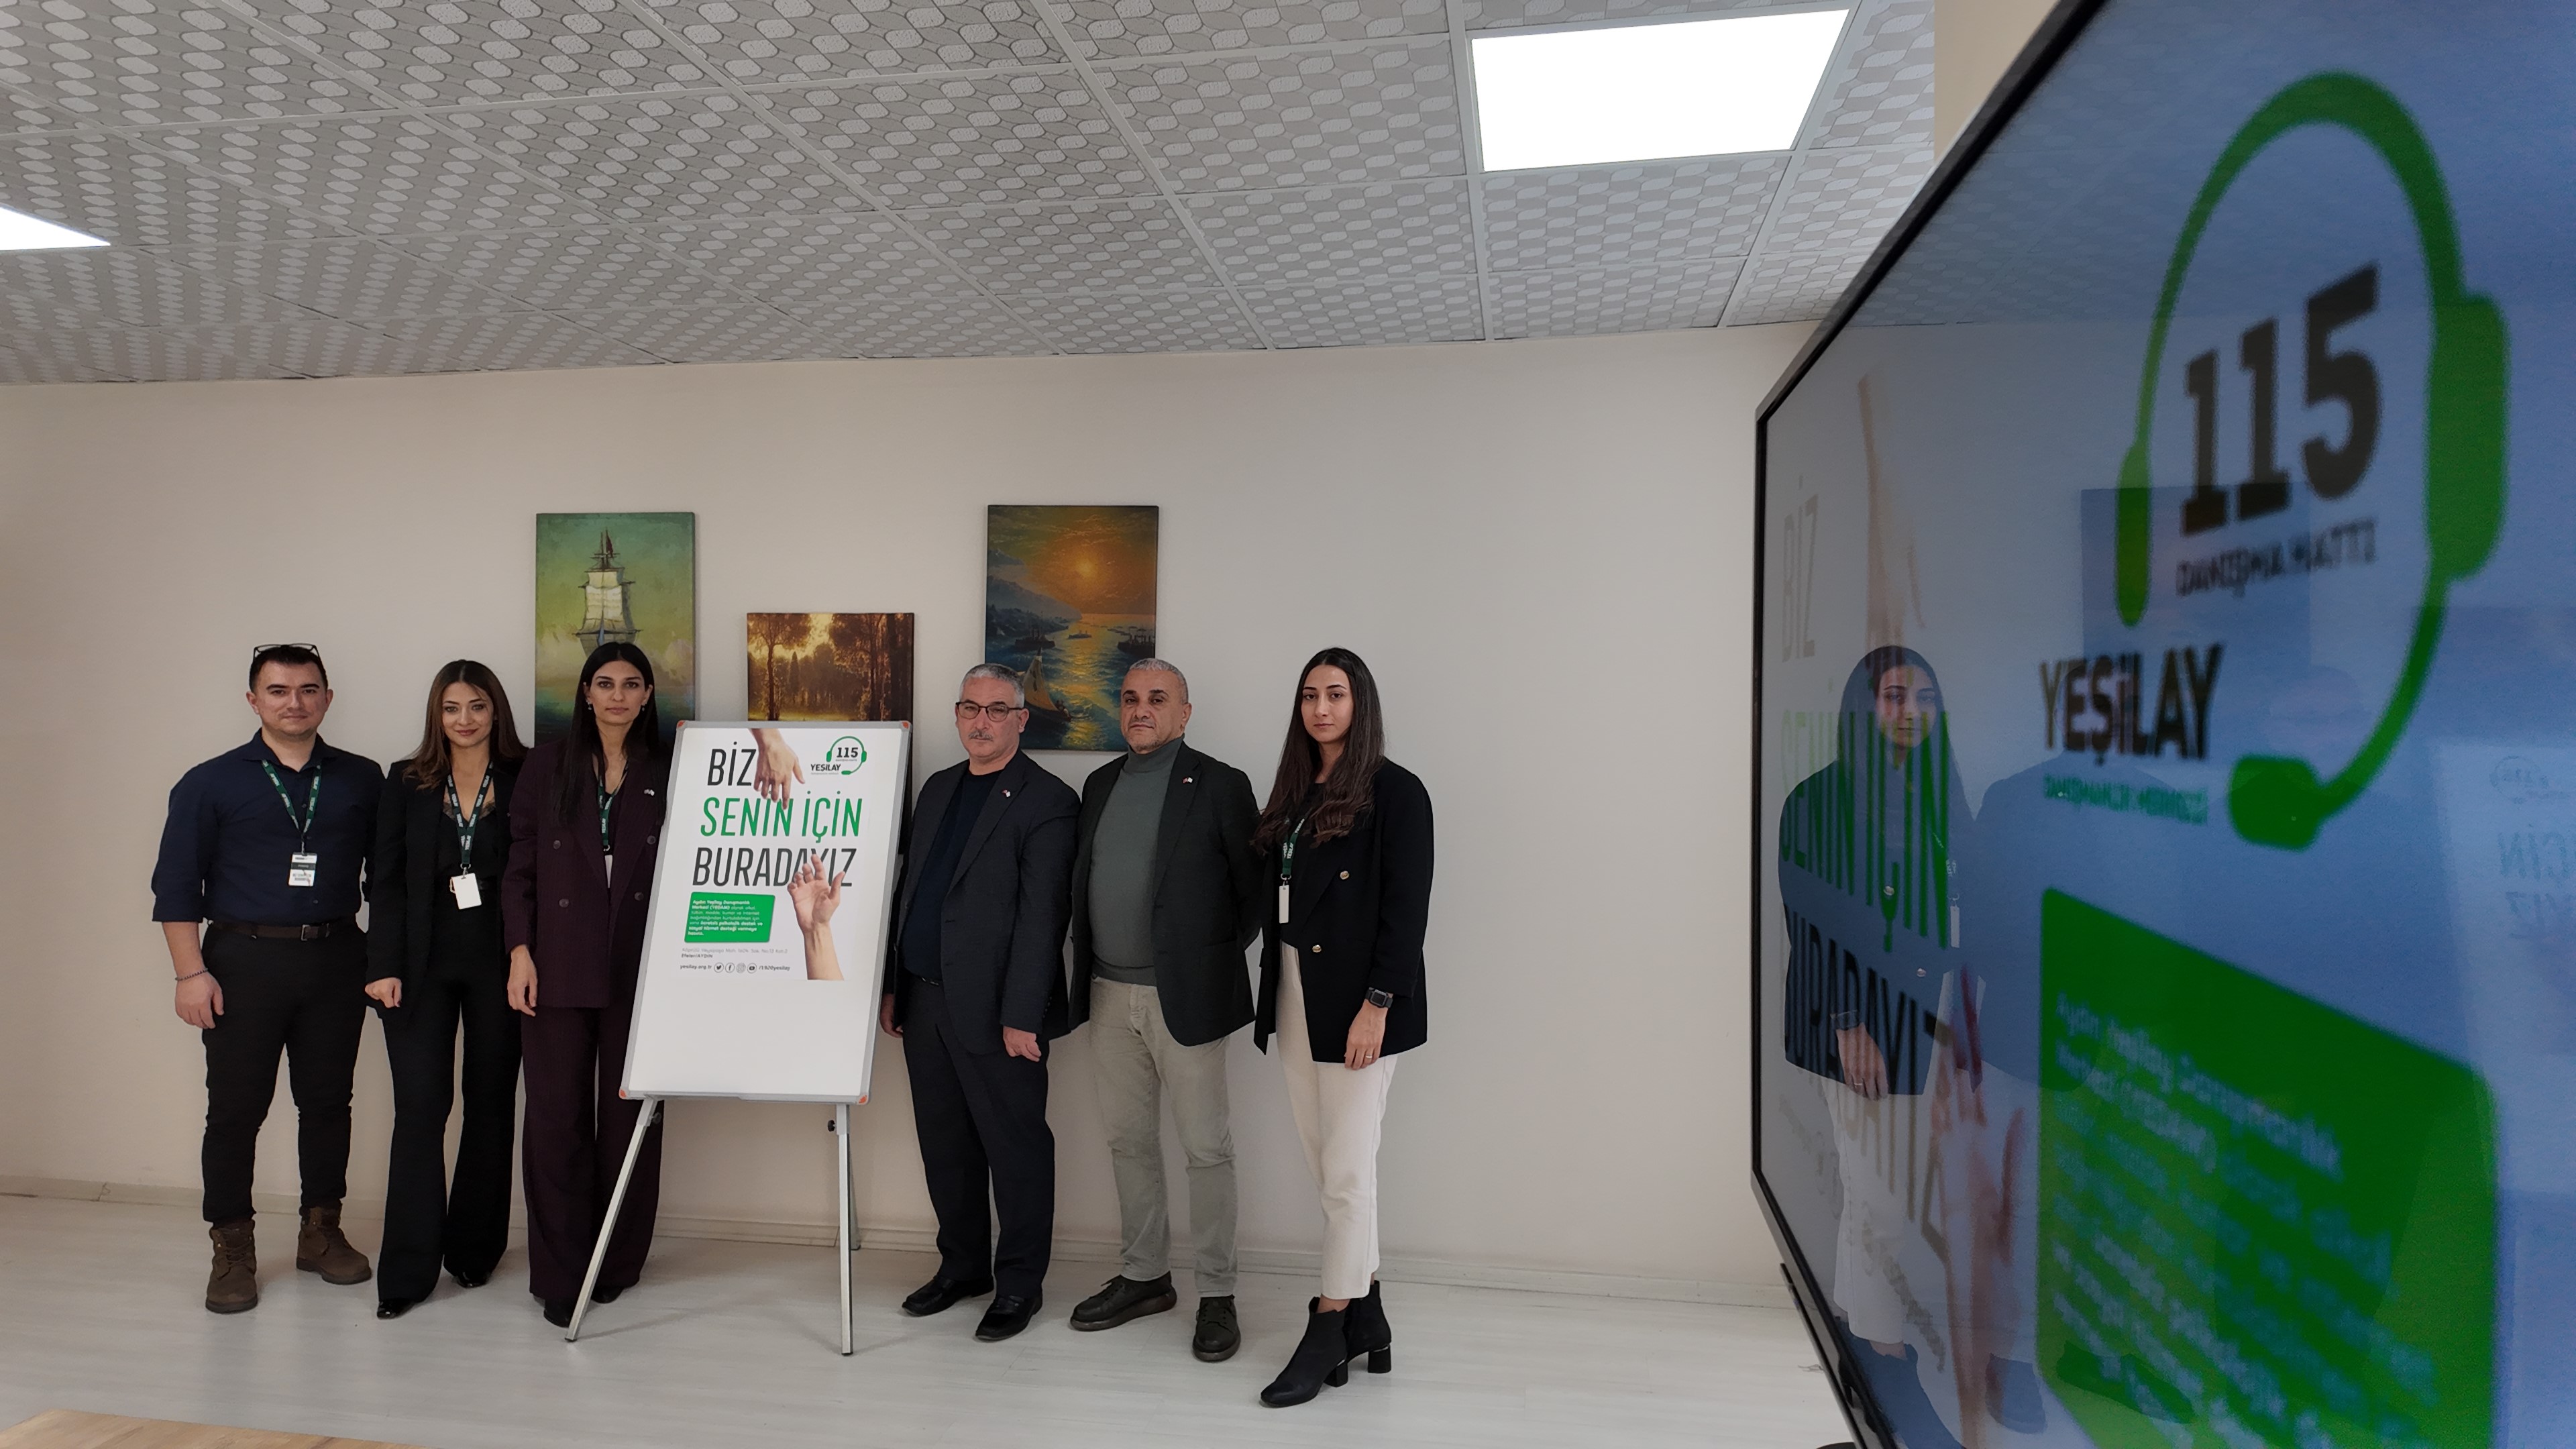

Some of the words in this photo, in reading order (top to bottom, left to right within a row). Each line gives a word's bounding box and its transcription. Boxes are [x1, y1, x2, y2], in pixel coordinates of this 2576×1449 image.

[2180, 262, 2382, 537] 115
[2039, 640, 2226, 765] YEŞİLAY
[707, 741, 757, 786] BİZ
[837, 747, 858, 758] 115
[700, 790, 794, 837] SENİN
[801, 790, 863, 843] İÇİN
